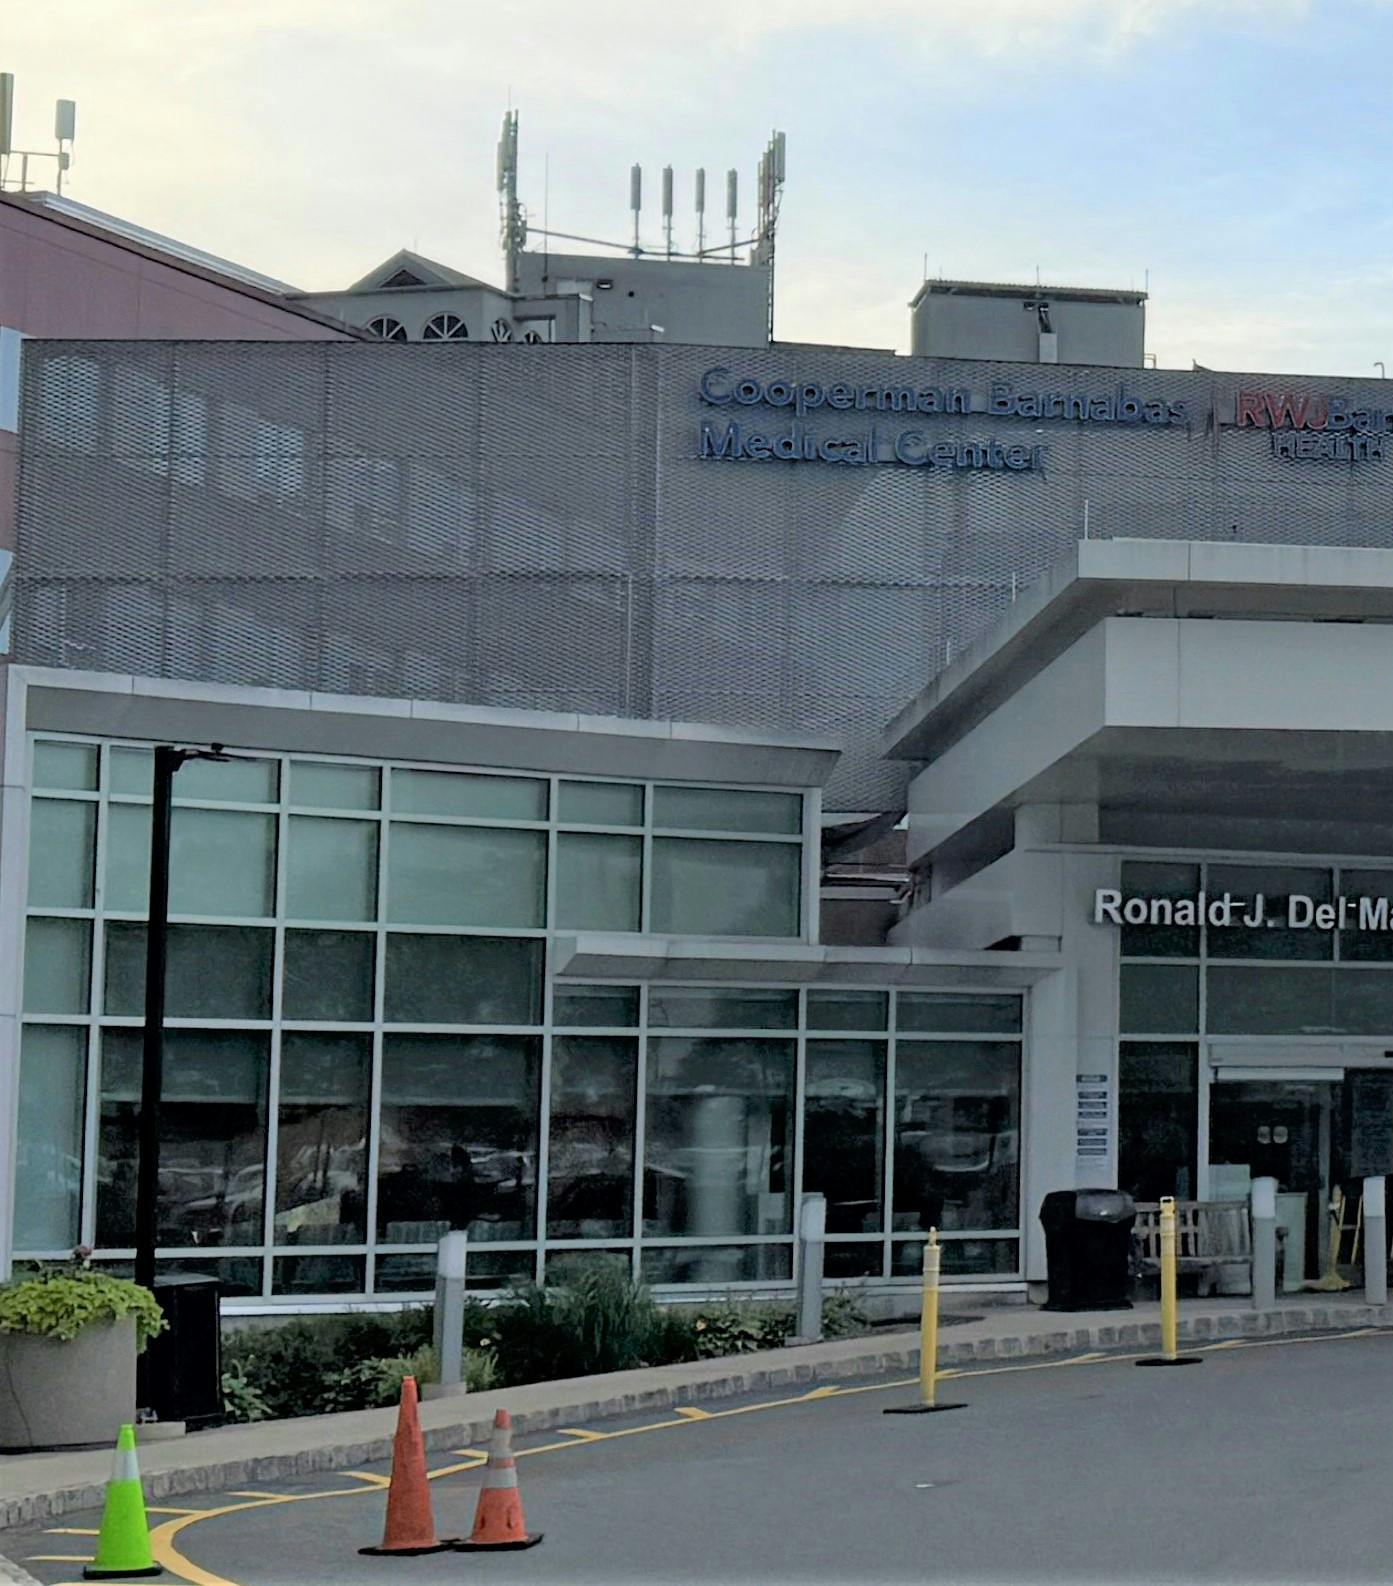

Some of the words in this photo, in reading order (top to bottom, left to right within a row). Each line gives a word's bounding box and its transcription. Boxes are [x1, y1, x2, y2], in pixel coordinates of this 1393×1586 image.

[699, 367, 972, 417] Cooperman
[988, 384, 1188, 424] Barnabas
[701, 422, 878, 464] Medical
[895, 430, 1048, 470] Center
[1271, 433, 1386, 461] HEALTH
[1095, 889, 1231, 927] Ronald
[1243, 894, 1275, 929] J.
[1288, 895, 1347, 930] Del
